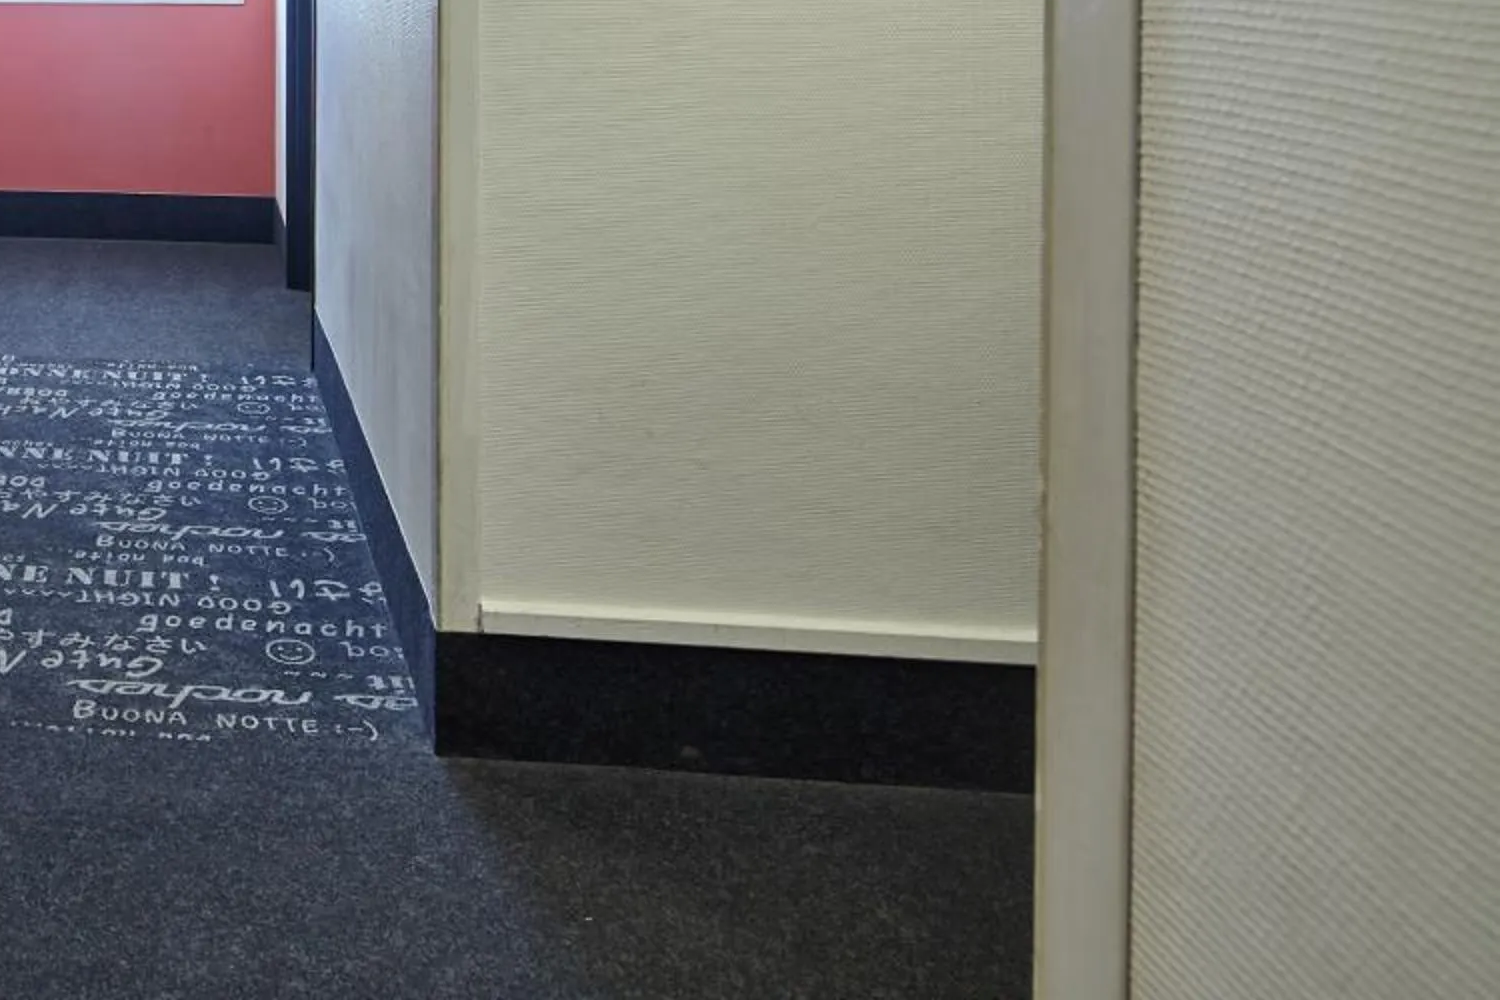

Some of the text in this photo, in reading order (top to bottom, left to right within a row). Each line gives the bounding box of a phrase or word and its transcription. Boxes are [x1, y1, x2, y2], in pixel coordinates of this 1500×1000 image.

[87, 450, 189, 465] NUIT
[96, 534, 185, 551] BUONA
[64, 566, 191, 590] NUIT
[74, 589, 292, 615] GOOD NIGHT
[135, 613, 388, 639] goedenacht
[40, 650, 164, 678] Gute
[72, 699, 188, 726] BUONA
[215, 713, 319, 733] NOTTE
